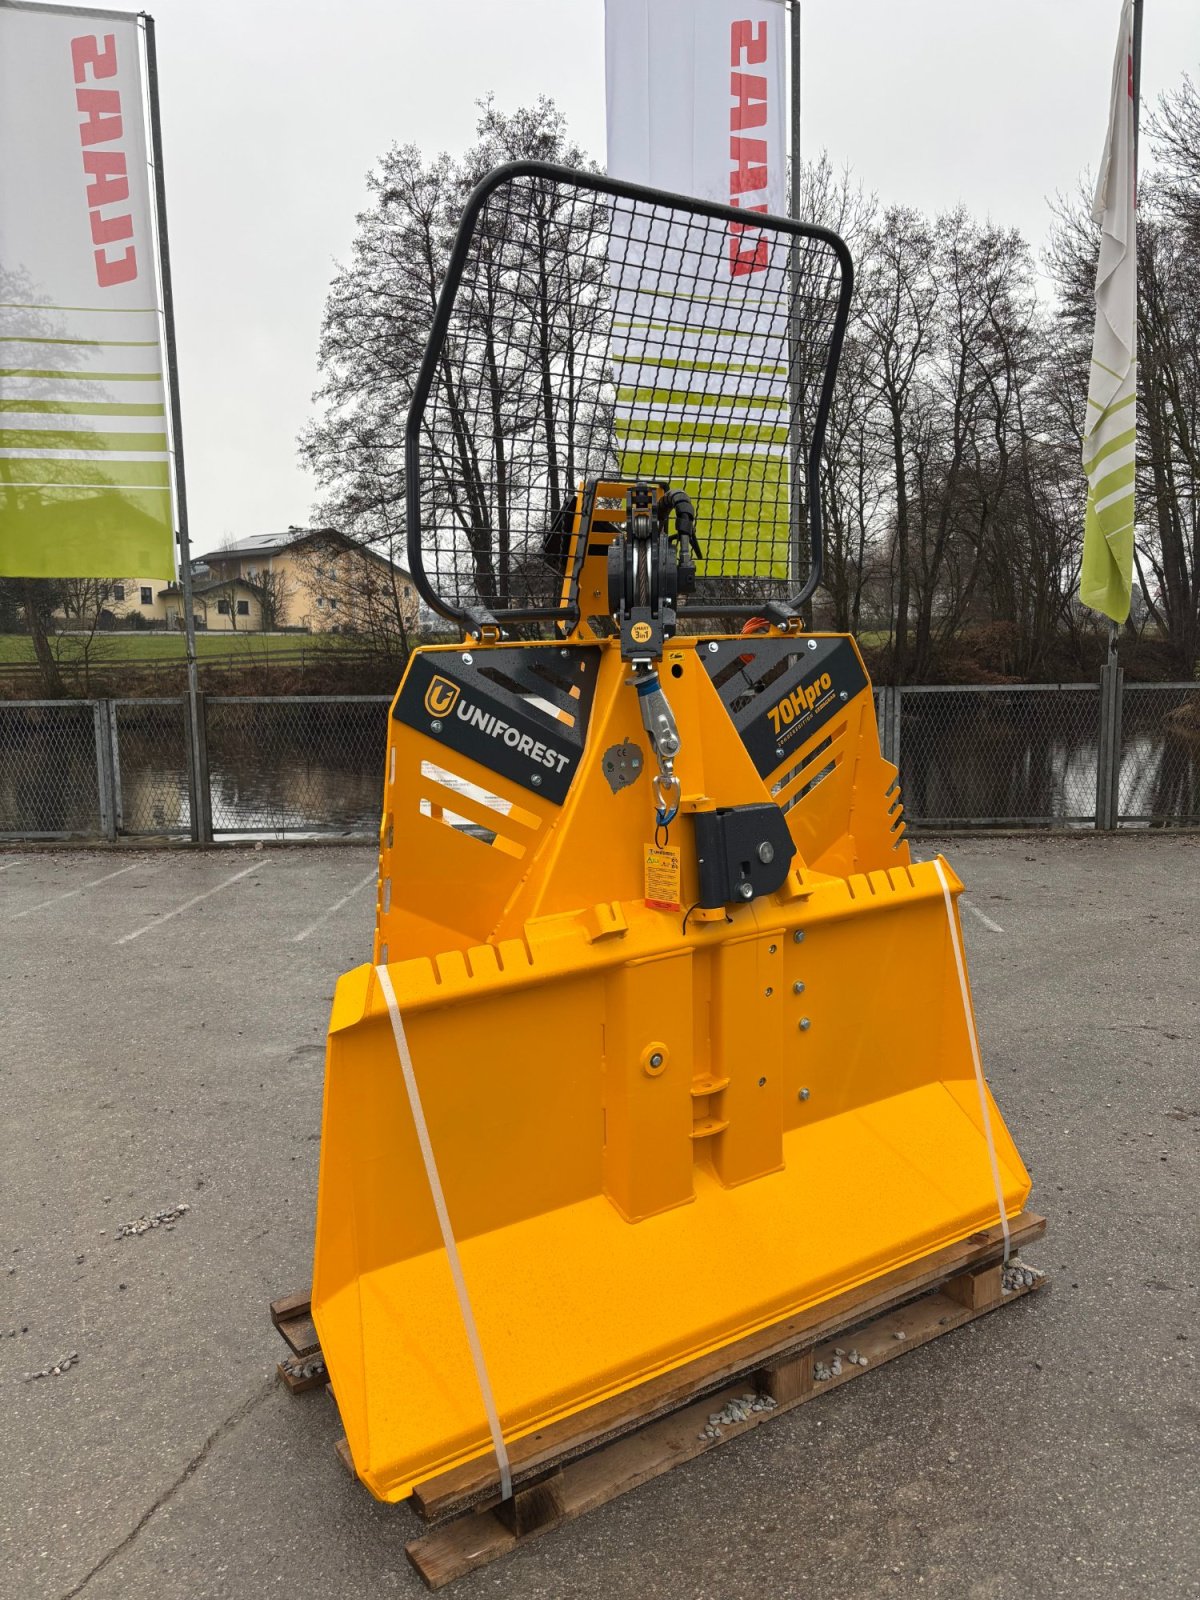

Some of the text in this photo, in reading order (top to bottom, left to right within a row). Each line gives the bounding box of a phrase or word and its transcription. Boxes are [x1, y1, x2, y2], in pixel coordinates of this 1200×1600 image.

[635, 631, 649, 639] 3in1
[767, 672, 831, 735] 70Hpro
[456, 699, 570, 773] UNIFOREST
[617, 748, 628, 757] CE
